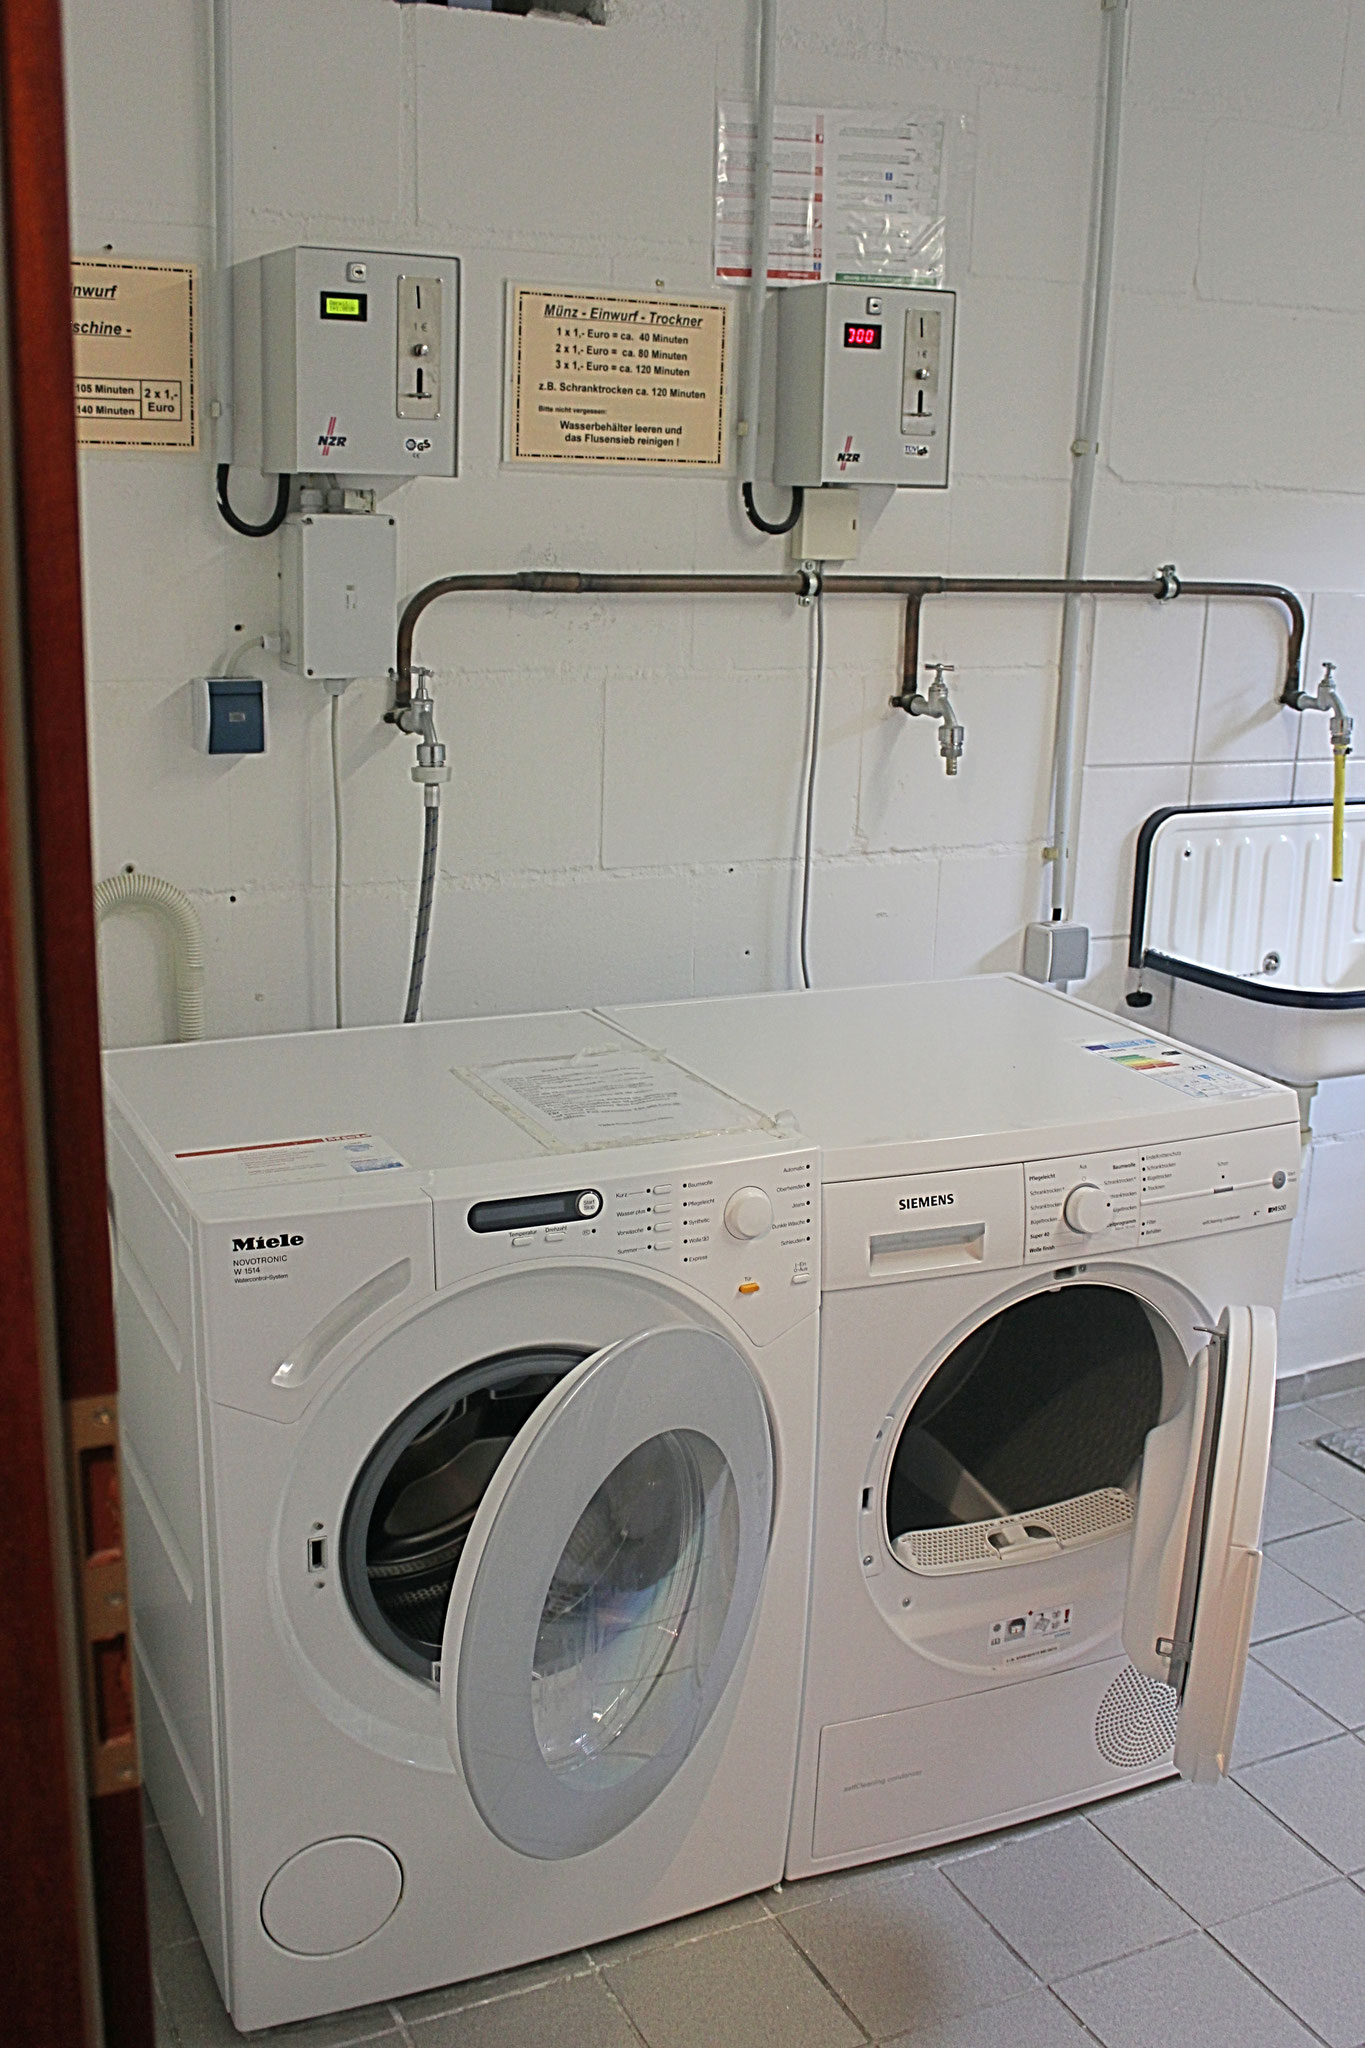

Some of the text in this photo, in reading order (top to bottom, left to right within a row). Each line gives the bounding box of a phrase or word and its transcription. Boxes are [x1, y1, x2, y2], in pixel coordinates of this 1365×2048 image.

[72, 285, 118, 298] nwurf
[544, 304, 579, 317] Münz
[590, 307, 639, 322] Einwurf
[650, 312, 703, 327] Trockner
[72, 321, 122, 335] schine
[557, 328, 561, 336] 1
[587, 329, 610, 339] Euro
[620, 332, 634, 341] ca.
[639, 333, 650, 342] 40
[652, 333, 689, 345] Minuten
[555, 344, 561, 353] 2
[586, 346, 609, 356] Euro
[622, 349, 635, 358] ca.
[638, 349, 649, 358] 80
[651, 350, 687, 361] Minuten
[555, 360, 561, 369] 3
[586, 362, 609, 372] Euro
[619, 365, 633, 374] ca.
[636, 365, 651, 374] 120
[654, 366, 690, 377] Minuten
[76, 384, 134, 395] 105 Minuten
[144, 388, 151, 398] 2
[154, 391, 161, 399] x
[539, 382, 706, 399] z.B. Schranktrocken ca. 120 Minuten
[77, 406, 135, 416] 140 Minuten
[147, 402, 175, 413] Euro
[560, 420, 682, 435] Wasserbehälter leeren und
[318, 436, 347, 447] NZR
[565, 433, 582, 442] das
[585, 434, 635, 445] Flusensieb
[637, 438, 674, 448] reinigen
[837, 453, 861, 462] NZR
[899, 1194, 954, 1210] SIEMENS
[509, 1229, 537, 1238] Temperatur
[617, 1228, 644, 1236] Vorwäsche
[232, 1234, 304, 1252] Miele
[617, 1247, 638, 1255] Summer
[233, 1255, 288, 1266] NOVOTRONIC
[244, 1267, 260, 1275] 1514
[234, 1274, 288, 1283] Watercontrol-System
